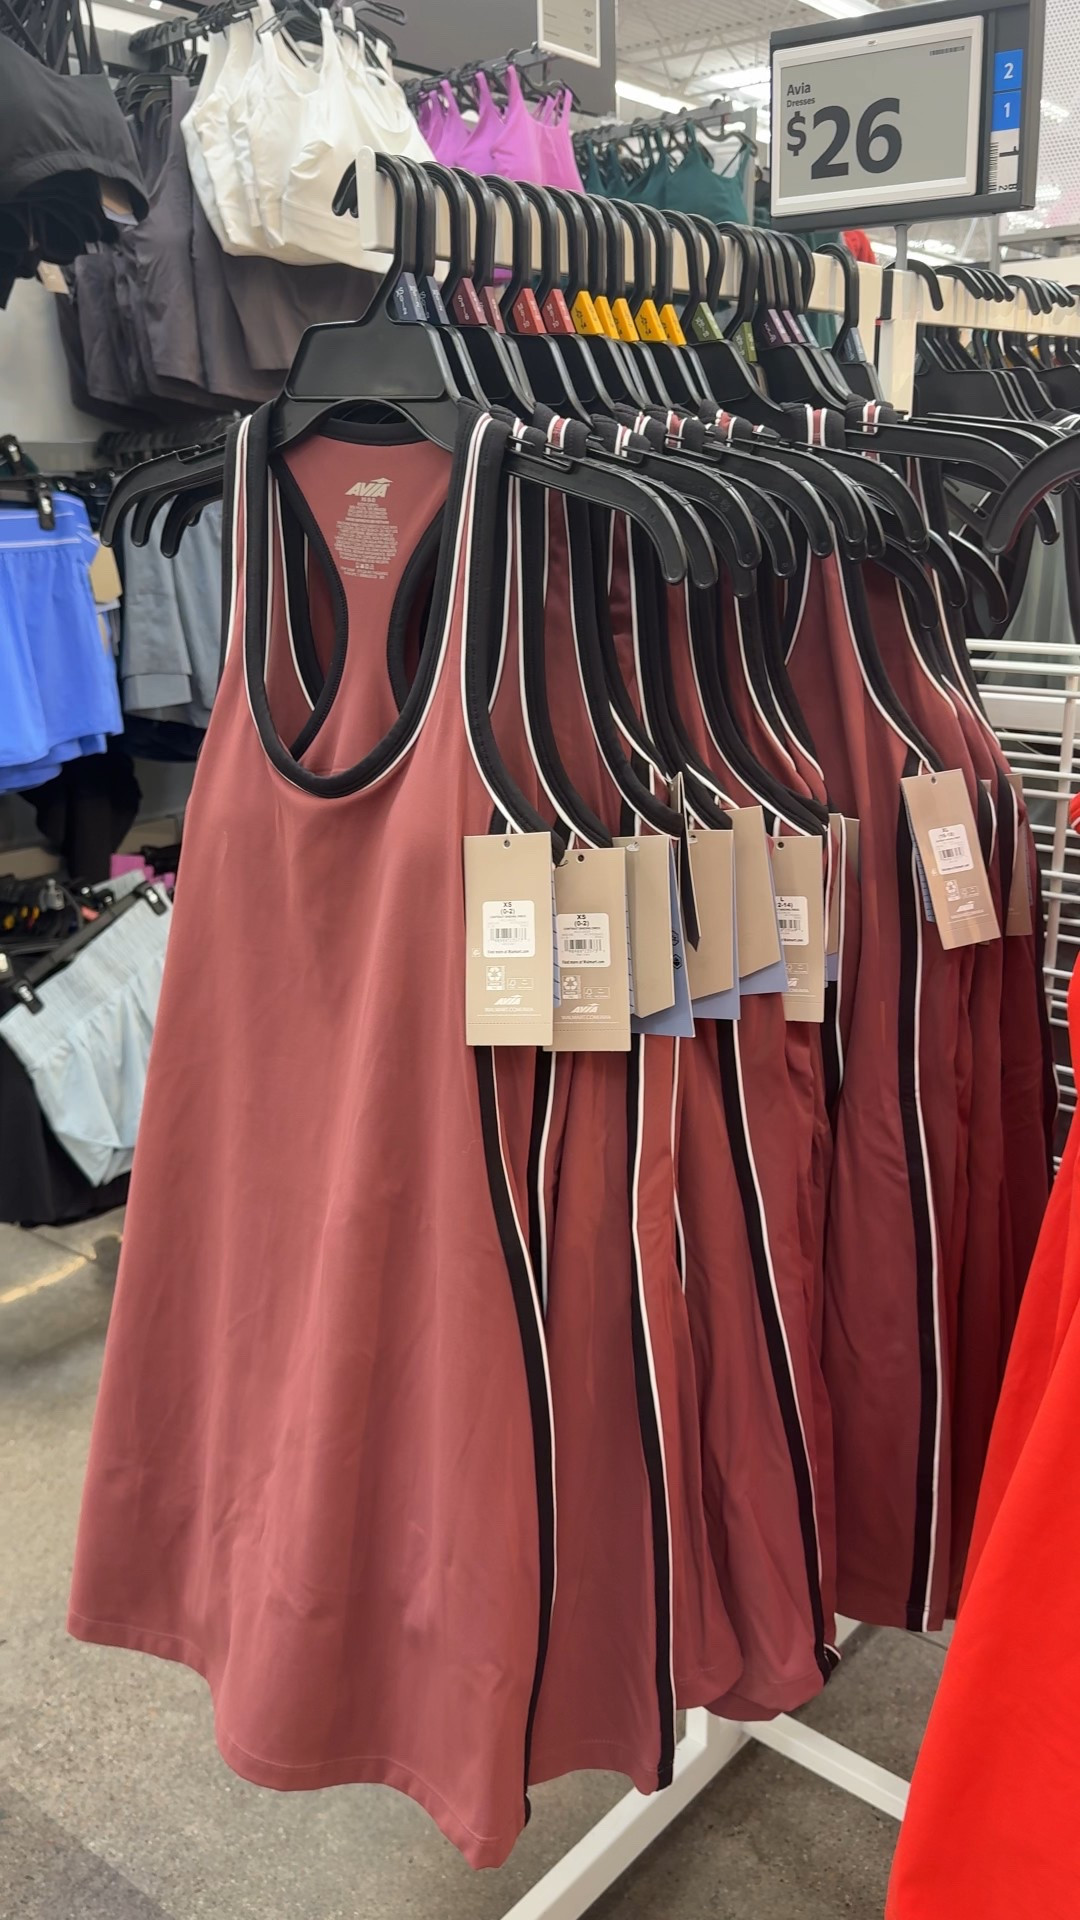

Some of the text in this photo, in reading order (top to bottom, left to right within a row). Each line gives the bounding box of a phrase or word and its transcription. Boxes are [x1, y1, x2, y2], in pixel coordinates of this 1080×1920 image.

[1003, 62, 1014, 80] 2
[786, 82, 811, 96] Avia
[786, 97, 815, 108] Dresses
[1004, 102, 1010, 119] 1
[786, 97, 903, 180] $26
[344, 479, 391, 498] AVIA
[500, 908, 515, 916] (0-2)
[573, 920, 590, 928] (0-2)
[494, 996, 522, 1005] AVIA
[571, 1004, 600, 1013] AVIA
